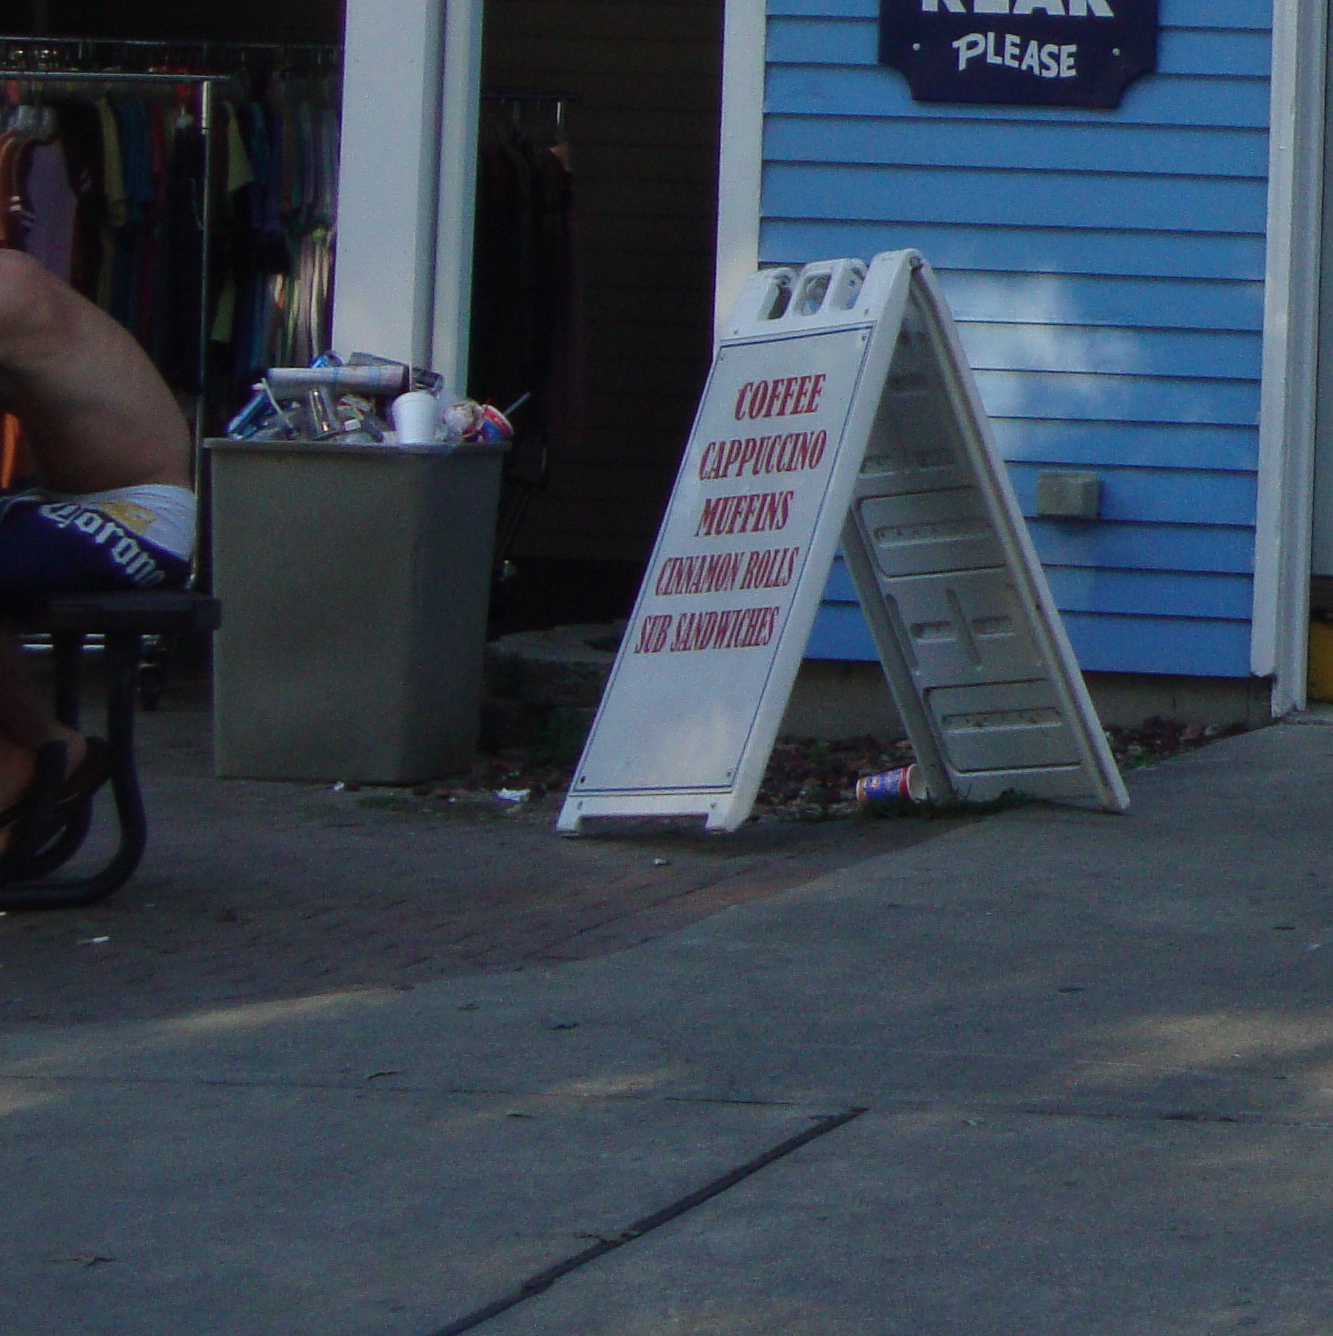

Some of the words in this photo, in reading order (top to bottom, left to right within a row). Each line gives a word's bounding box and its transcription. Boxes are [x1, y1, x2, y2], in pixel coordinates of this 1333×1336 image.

[952, 32, 1077, 78] PLEASE
[734, 374, 826, 421] COFFEE
[698, 430, 828, 481] CAPPUCCINO
[694, 491, 794, 537] MUFFINS
[655, 551, 745, 596] CINNAMON
[738, 547, 800, 590] ROLLS
[634, 615, 673, 654] SUB
[669, 607, 780, 653] SANDWICHES
